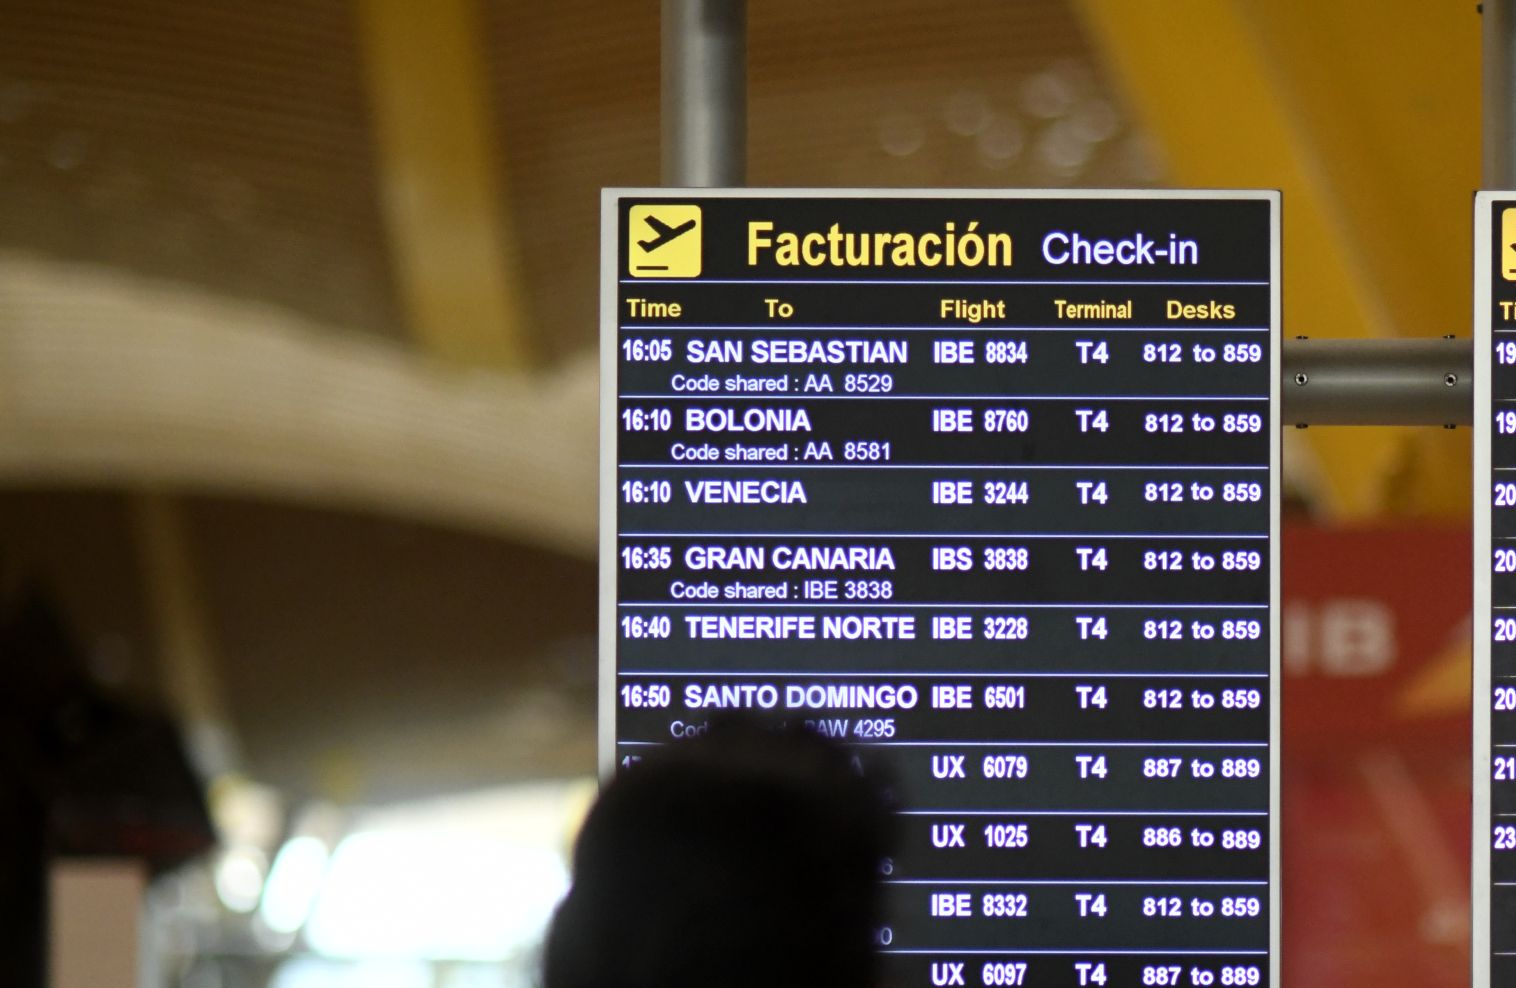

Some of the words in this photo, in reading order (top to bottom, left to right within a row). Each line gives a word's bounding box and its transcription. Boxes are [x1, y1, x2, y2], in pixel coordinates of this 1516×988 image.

[749, 222, 1011, 266] Facturación
[1043, 233, 1197, 264] Check-in
[626, 299, 681, 317] Time
[765, 299, 793, 317] To
[941, 300, 1005, 323] Flight
[1054, 300, 1131, 318] Terminal
[1167, 301, 1235, 319] Desks
[623, 339, 672, 361] 16:05
[687, 340, 742, 363] SAN
[751, 340, 907, 363] SEBASTIAN
[934, 341, 974, 363] IBE
[986, 342, 1027, 363] 8834
[1076, 342, 1109, 363] T4
[1144, 344, 1181, 362] 812
[1193, 344, 1215, 362] to
[1223, 344, 1261, 362] 859
[672, 374, 720, 391] Code
[725, 374, 788, 391] shared
[804, 374, 833, 392] AA
[845, 374, 892, 392] 8529
[623, 409, 671, 430] 16:10
[686, 408, 811, 431] BOLONIA
[933, 410, 973, 431] IBE
[985, 410, 1028, 432] 8760
[1076, 410, 1108, 432] T4
[1145, 414, 1183, 432] 812
[1192, 413, 1215, 431] to
[1223, 414, 1261, 432] 859
[621, 685, 670, 707] 16:50
[685, 685, 778, 708] SANTO
[786, 685, 917, 708] DOMINGO
[932, 686, 972, 708] IBE
[985, 686, 1024, 708] 6501
[1076, 686, 1107, 708] T4
[1144, 690, 1182, 708] 812
[1191, 690, 1214, 708] to
[1222, 690, 1260, 708] 859
[933, 825, 965, 847] UX
[985, 825, 1028, 847] 1025
[1075, 825, 1107, 847] T4
[1143, 828, 1181, 846] 886
[1191, 828, 1214, 846] to
[1222, 830, 1260, 849] 889
